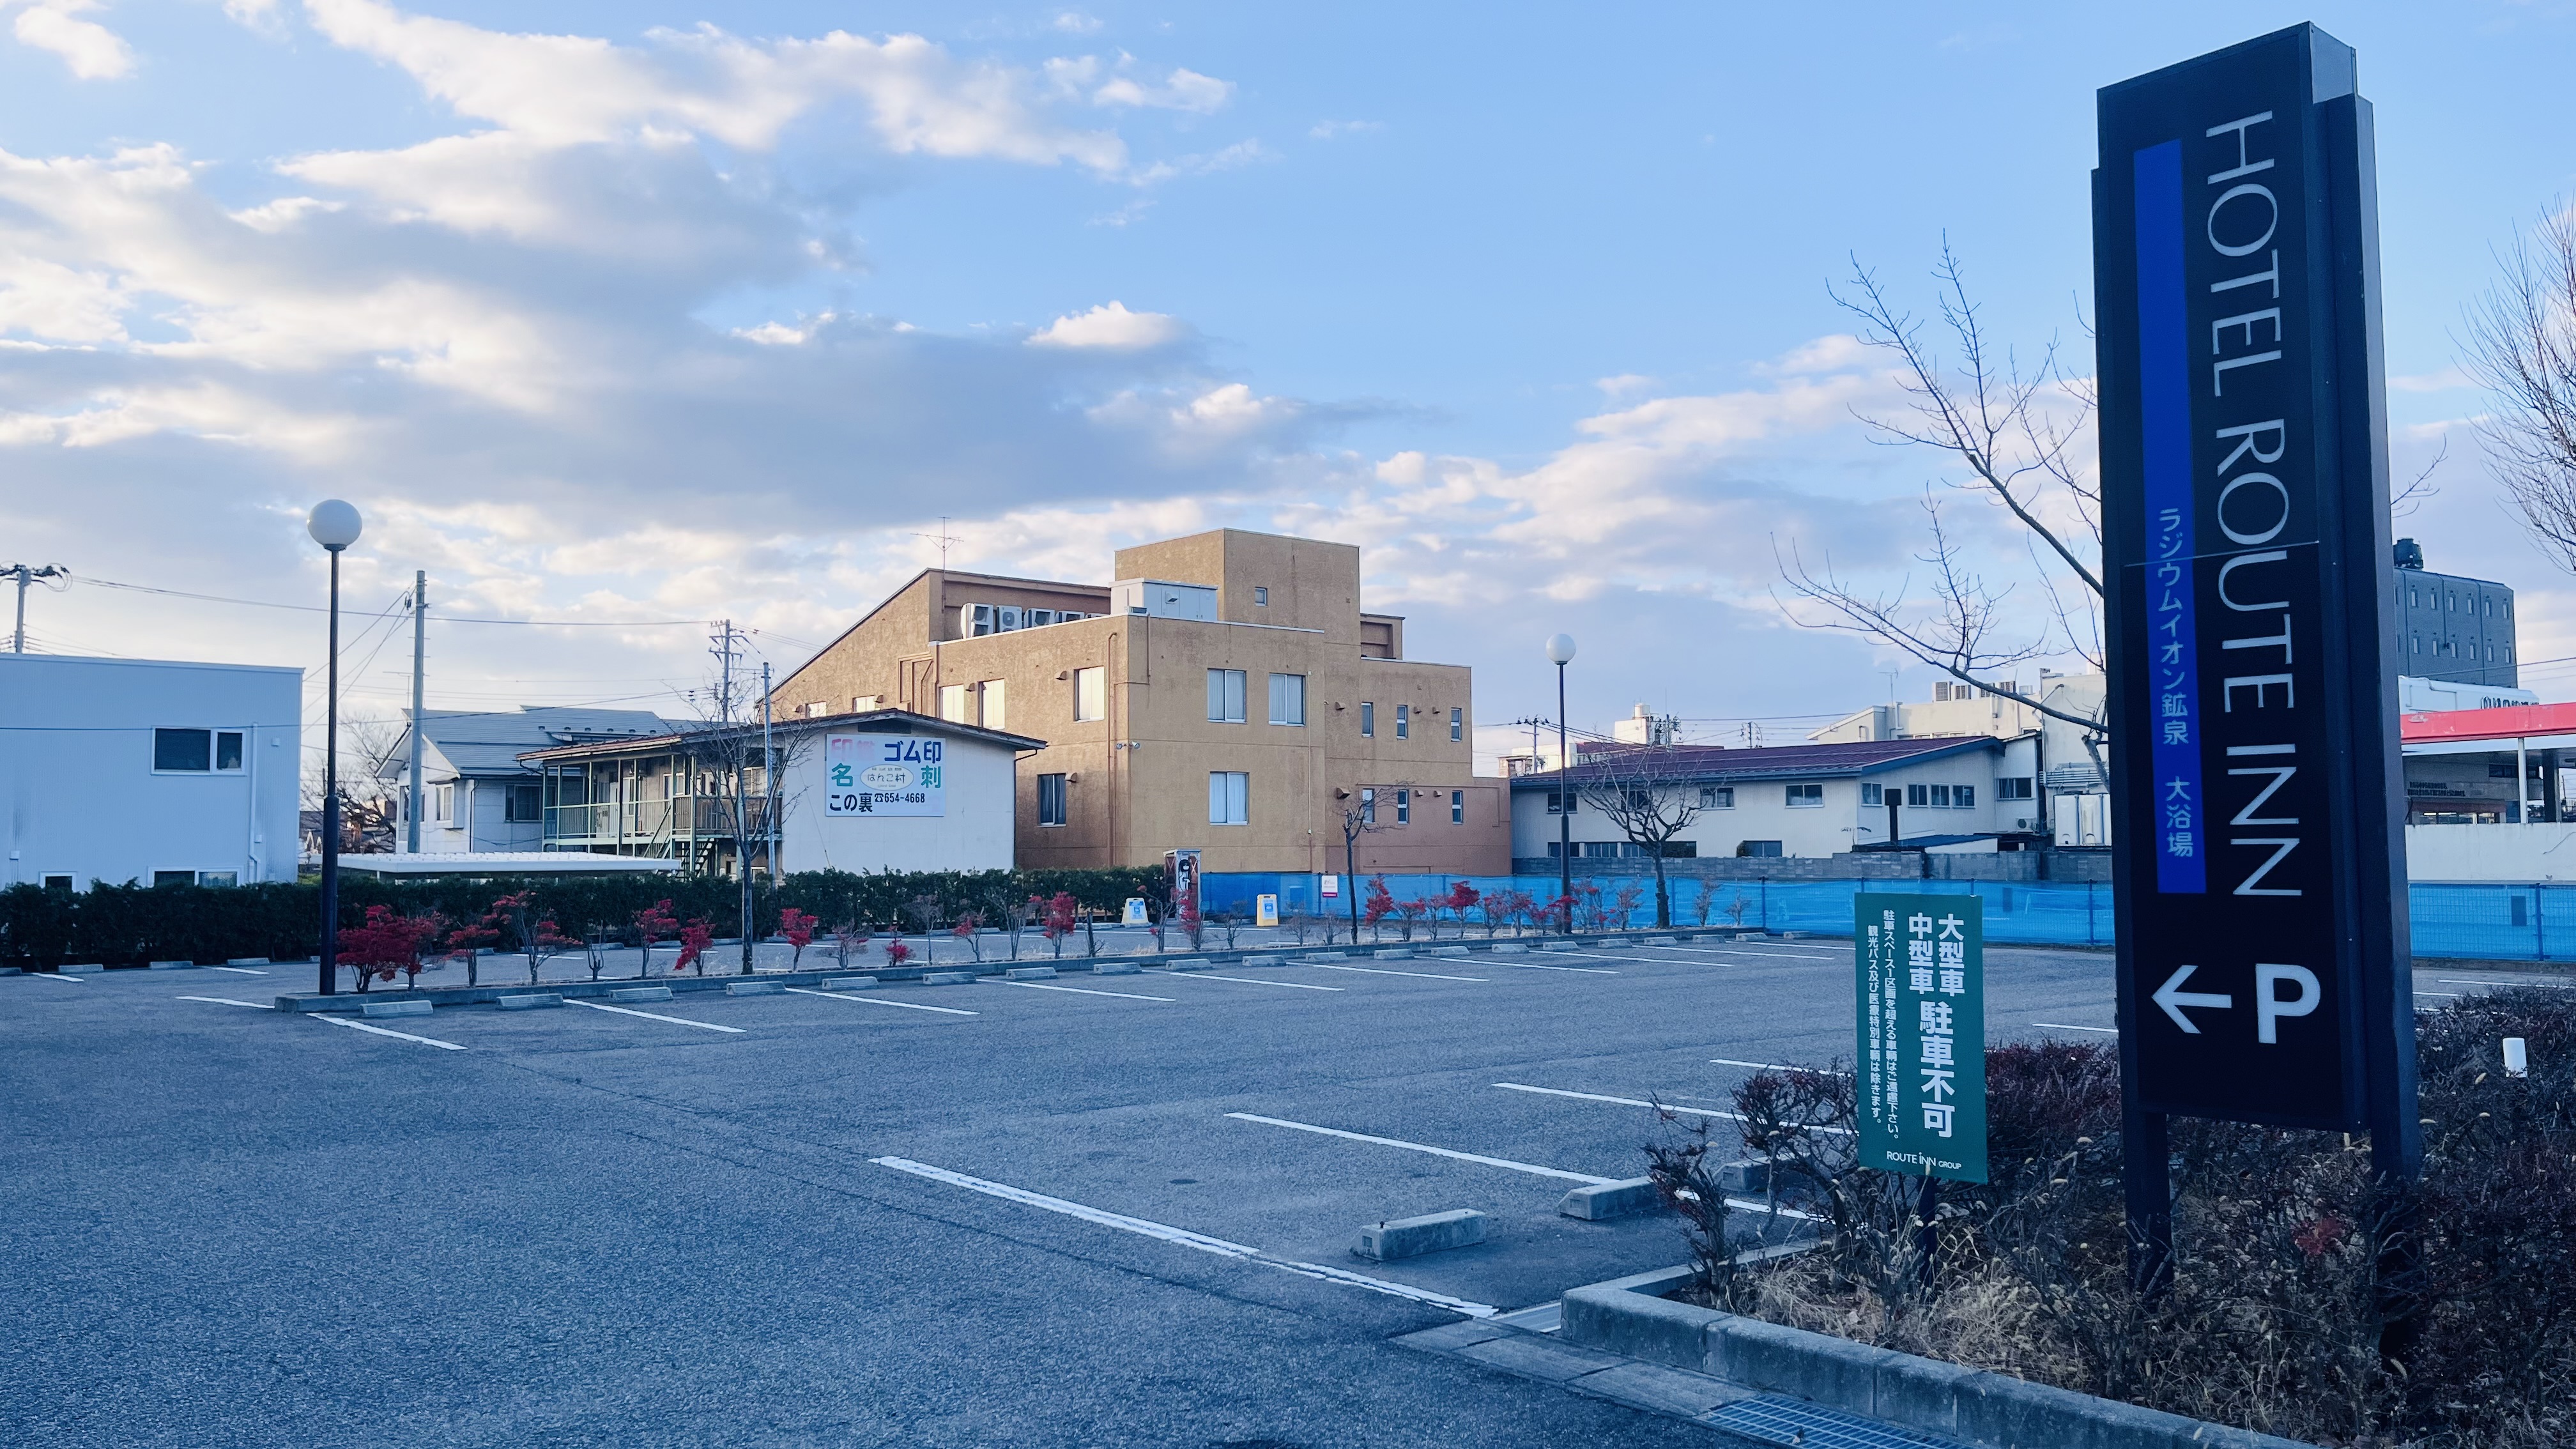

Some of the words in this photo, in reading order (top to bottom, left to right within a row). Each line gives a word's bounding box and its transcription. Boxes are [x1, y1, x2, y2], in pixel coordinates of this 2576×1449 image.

[2205, 110, 2283, 397] HOTEL
[2216, 418, 2296, 713] ROUTE
[2158, 507, 2189, 745] ラジウムイオン鉱泉
[831, 763, 854, 786] 名
[921, 765, 941, 788] 刺
[867, 772, 905, 784] はんこ村
[884, 740, 941, 763] ゴム印
[829, 792, 873, 813] この裏
[884, 792, 925, 803] 654-4668
[2165, 775, 2194, 858] 大浴場
[2226, 743, 2303, 896] INN
[1908, 912, 1934, 995] 中型車
[1938, 913, 1965, 997] 大型車
[2255, 963, 2322, 1045] P
[1919, 1000, 1955, 1138] 駐車不可
[1887, 1151, 1917, 1164] ROUTE
[1938, 1160, 1961, 1170] GROUP
